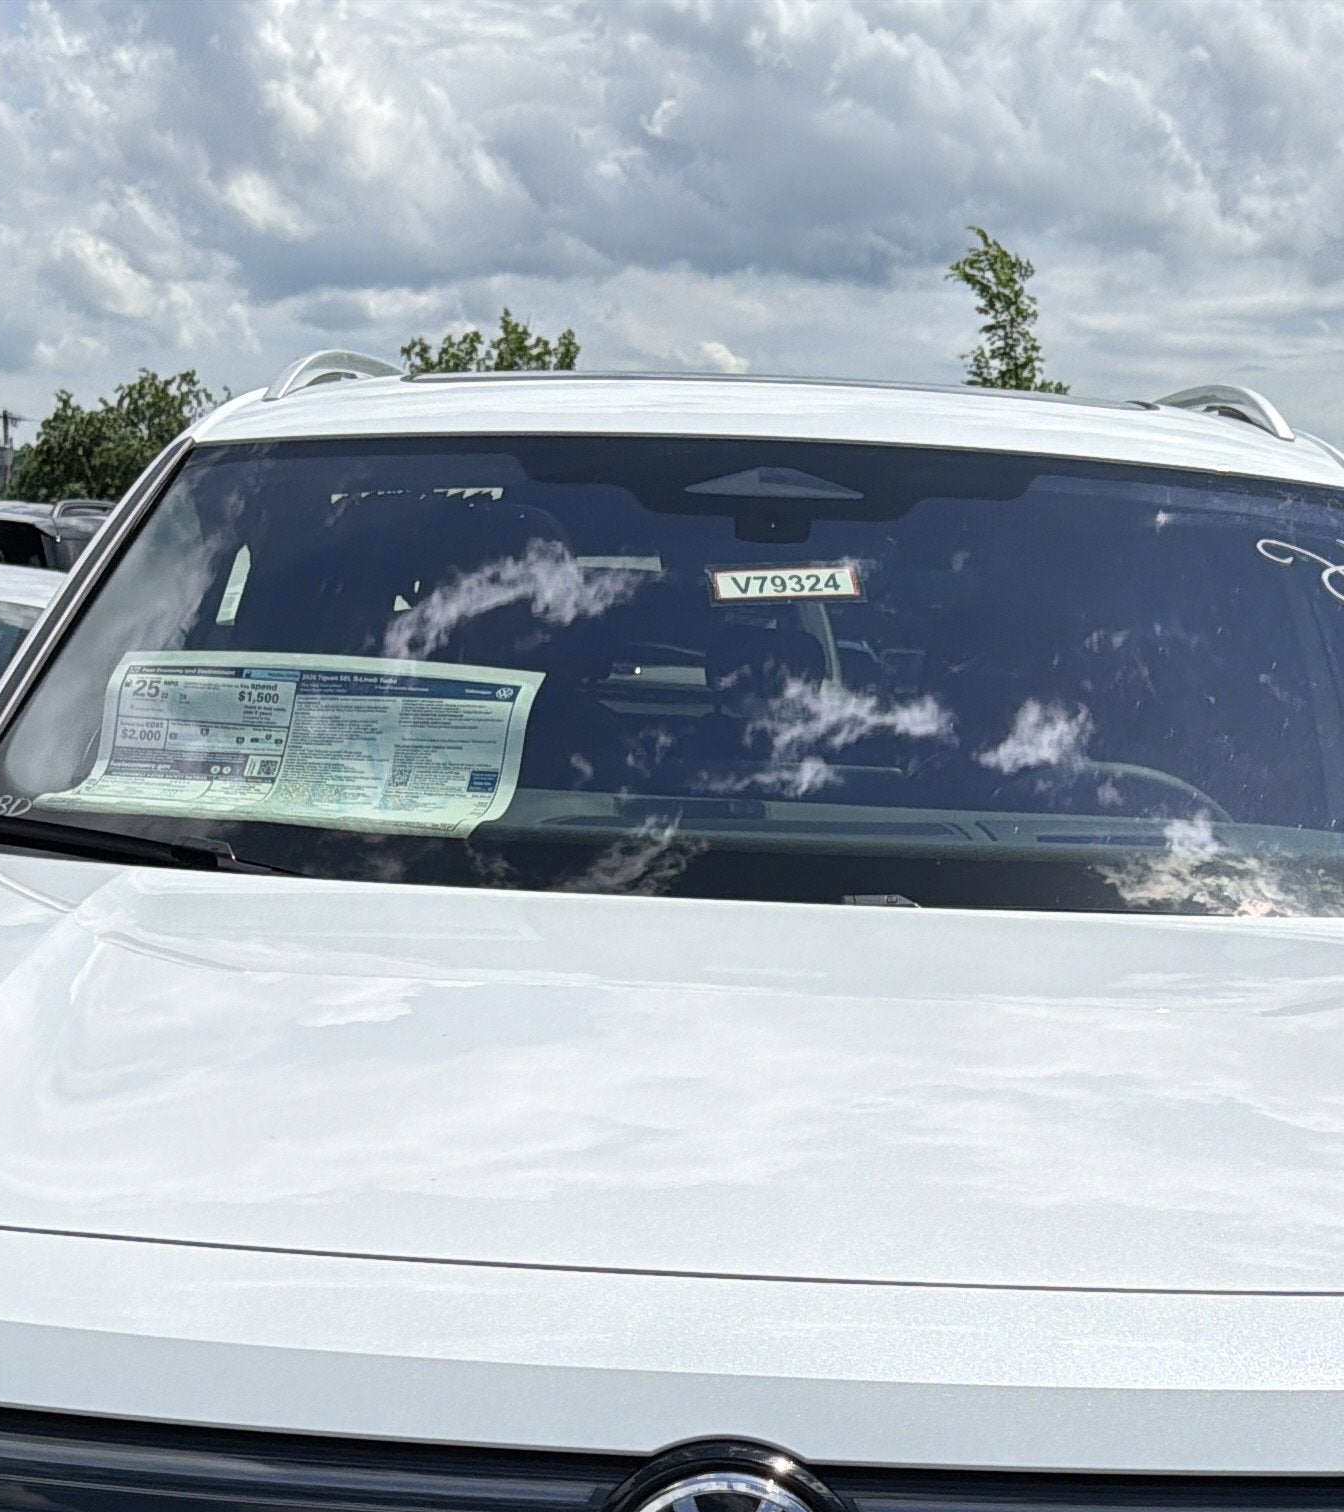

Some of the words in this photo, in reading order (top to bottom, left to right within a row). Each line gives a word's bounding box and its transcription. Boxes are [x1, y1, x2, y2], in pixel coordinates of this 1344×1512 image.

[730, 573, 842, 595] V79324
[133, 679, 161, 699] 25
[238, 691, 280, 705] $1,500
[121, 727, 161, 741] $2,000
